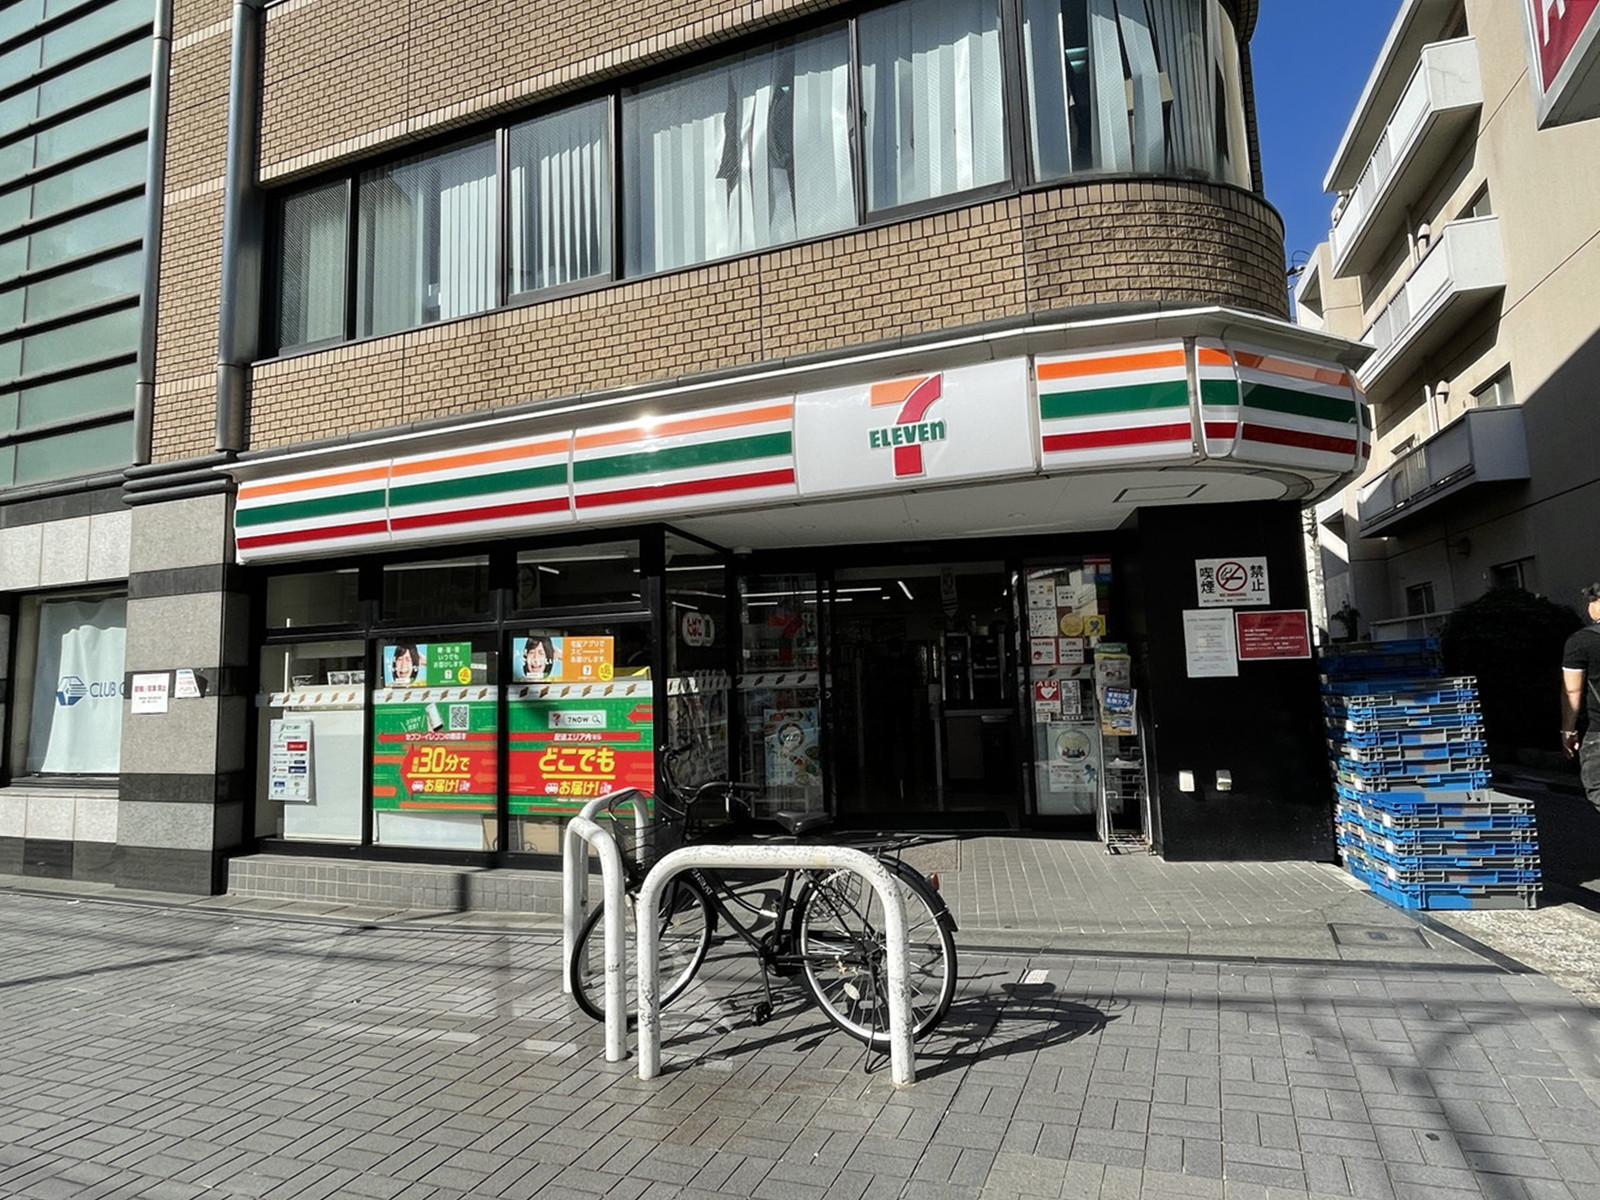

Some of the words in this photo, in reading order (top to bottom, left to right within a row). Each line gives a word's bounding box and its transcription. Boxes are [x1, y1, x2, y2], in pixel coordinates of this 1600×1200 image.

[871, 373, 942, 476] 7
[1200, 567, 1215, 594] 喫煙
[1250, 565, 1265, 592] 禁止
[90, 682, 116, 698] CLUB
[538, 747, 616, 773] どこでも
[559, 780, 600, 796] お届け!
